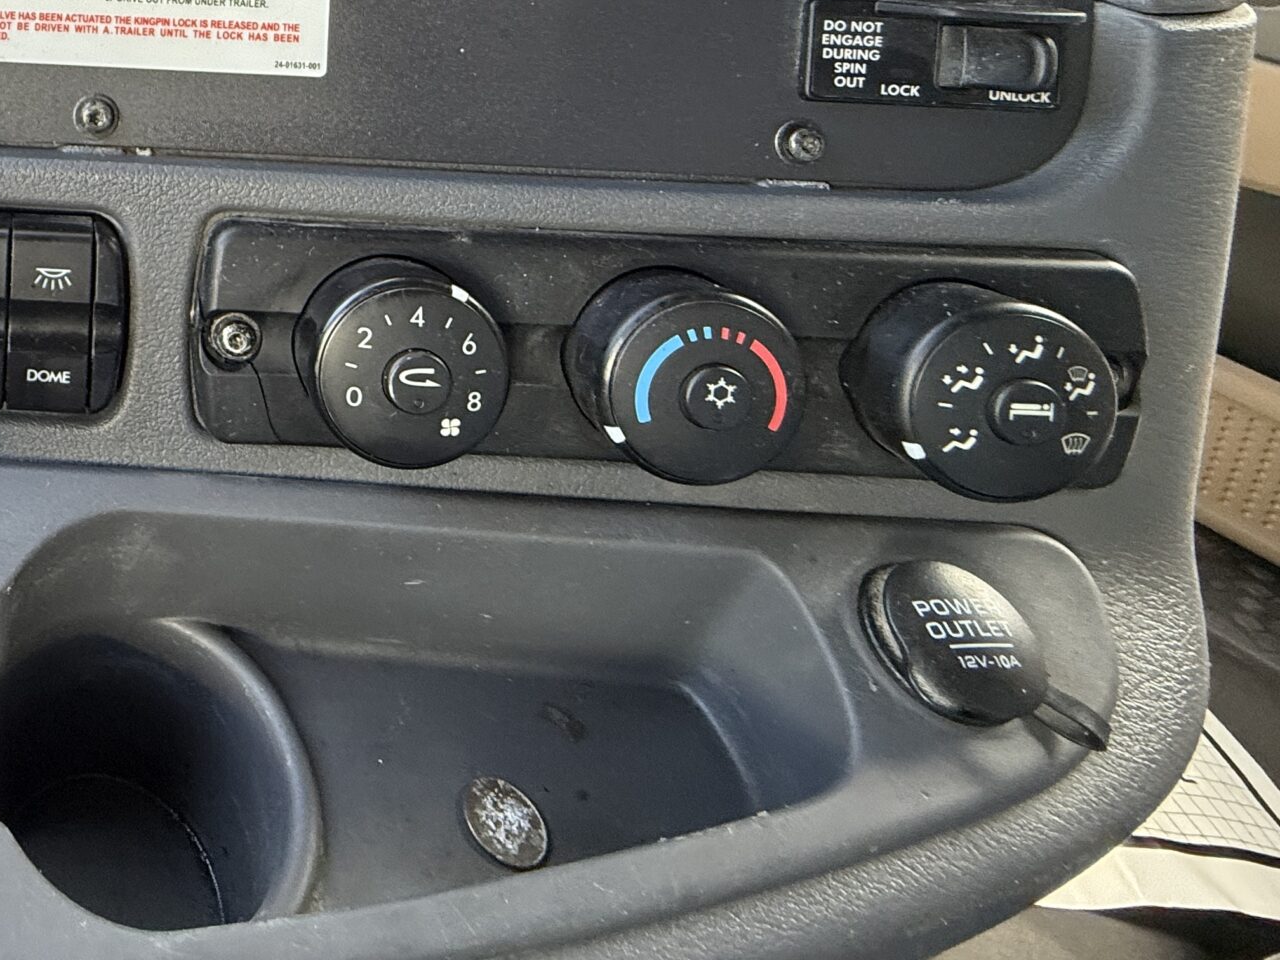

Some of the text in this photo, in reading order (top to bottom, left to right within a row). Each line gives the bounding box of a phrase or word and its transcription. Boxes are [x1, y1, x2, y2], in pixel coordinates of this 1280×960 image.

[824, 19, 884, 33] DO NOT
[822, 34, 883, 48] ENGAGE
[822, 48, 881, 62] DURING
[834, 62, 867, 75] SPIN
[833, 76, 866, 89] OUT
[880, 84, 920, 97] LOCK
[988, 90, 1051, 104] UNLOCK
[409, 305, 426, 328] 4
[357, 326, 373, 349] 2
[461, 332, 477, 355] 6
[26, 369, 71, 384] DOME
[345, 386, 363, 407] 0
[466, 391, 482, 412] 8
[911, 598, 1004, 618] POWER
[925, 620, 1014, 640] OUTLET
[957, 654, 1022, 670] 12V-10A
